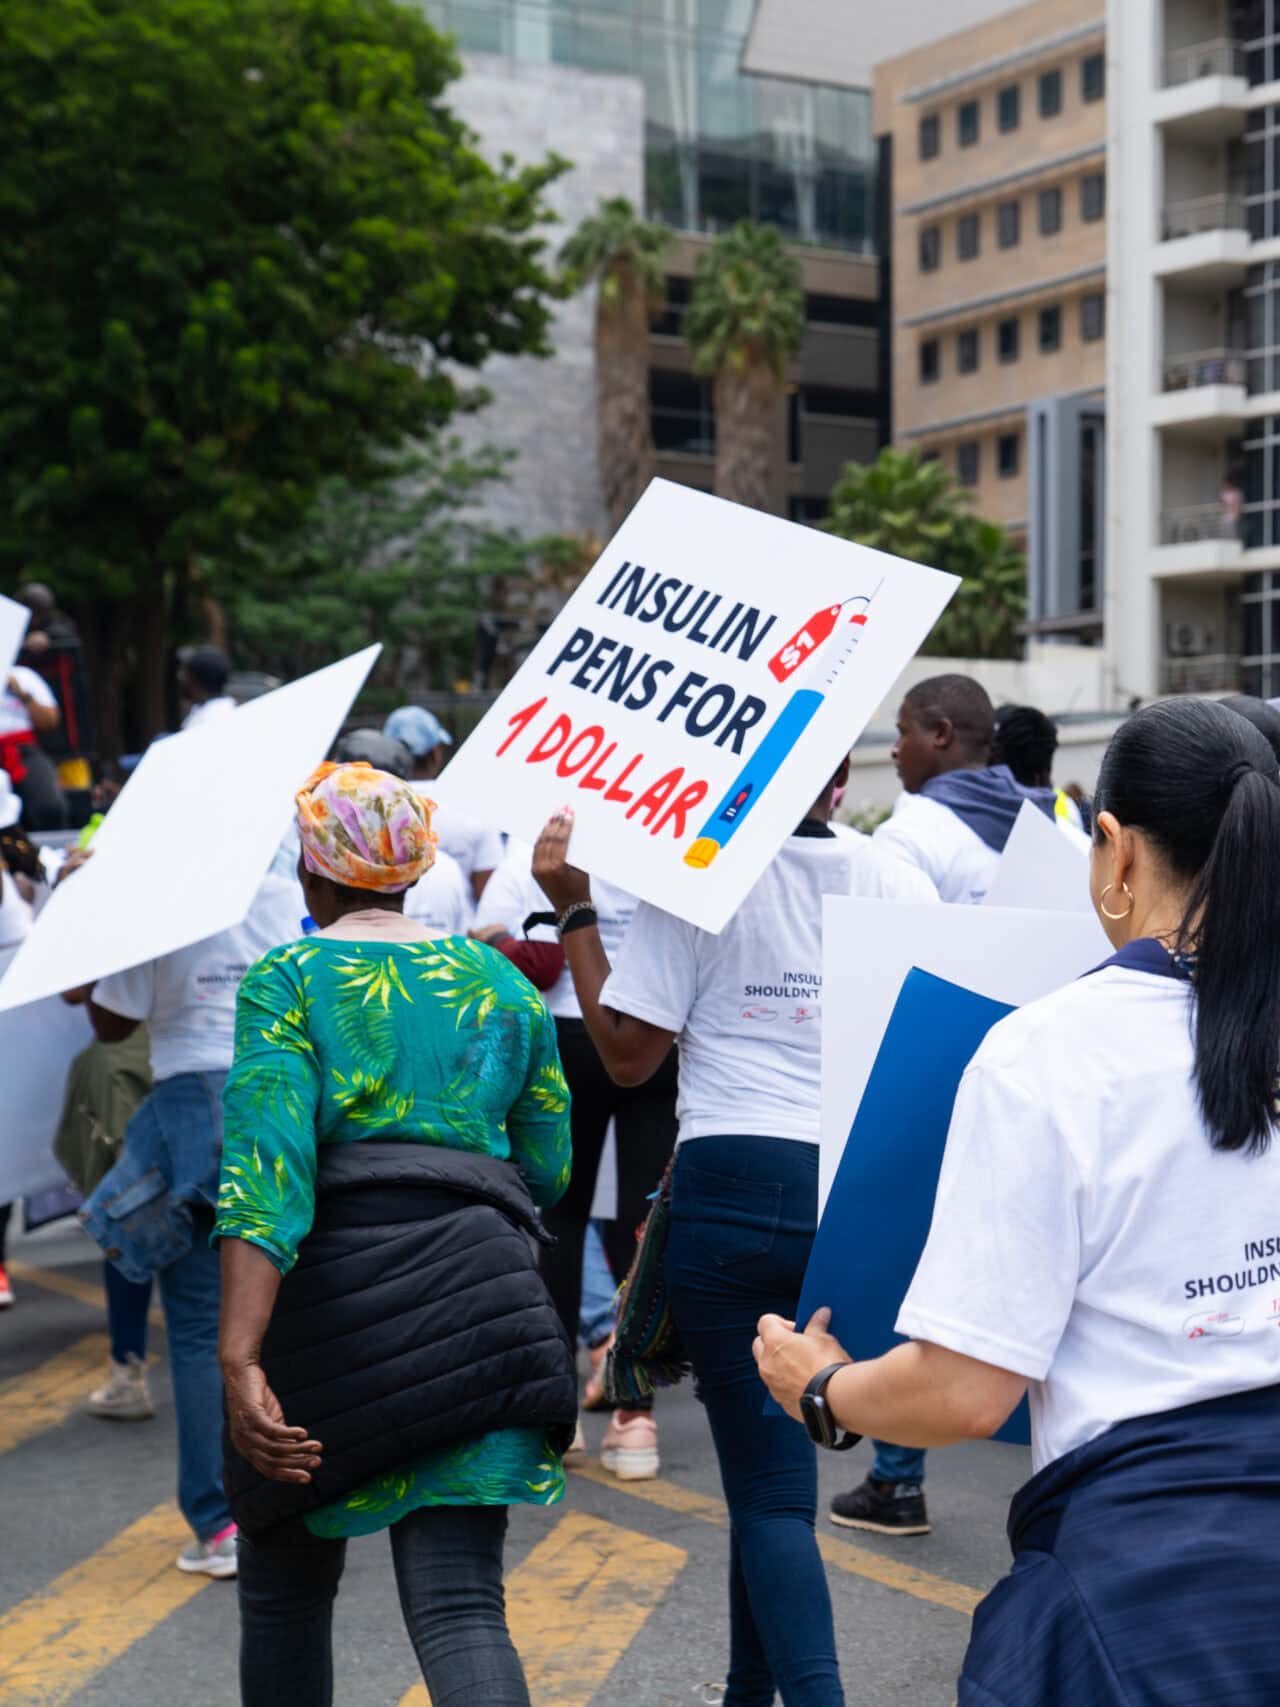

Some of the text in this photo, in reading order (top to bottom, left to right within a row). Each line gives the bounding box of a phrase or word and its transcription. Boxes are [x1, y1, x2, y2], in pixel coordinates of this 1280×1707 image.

[596, 561, 777, 662] INSULIN
[779, 630, 816, 672] $1
[547, 627, 767, 756] PENS FOR
[495, 697, 708, 839] 1 DOLLAR
[784, 973, 822, 985] INSULI
